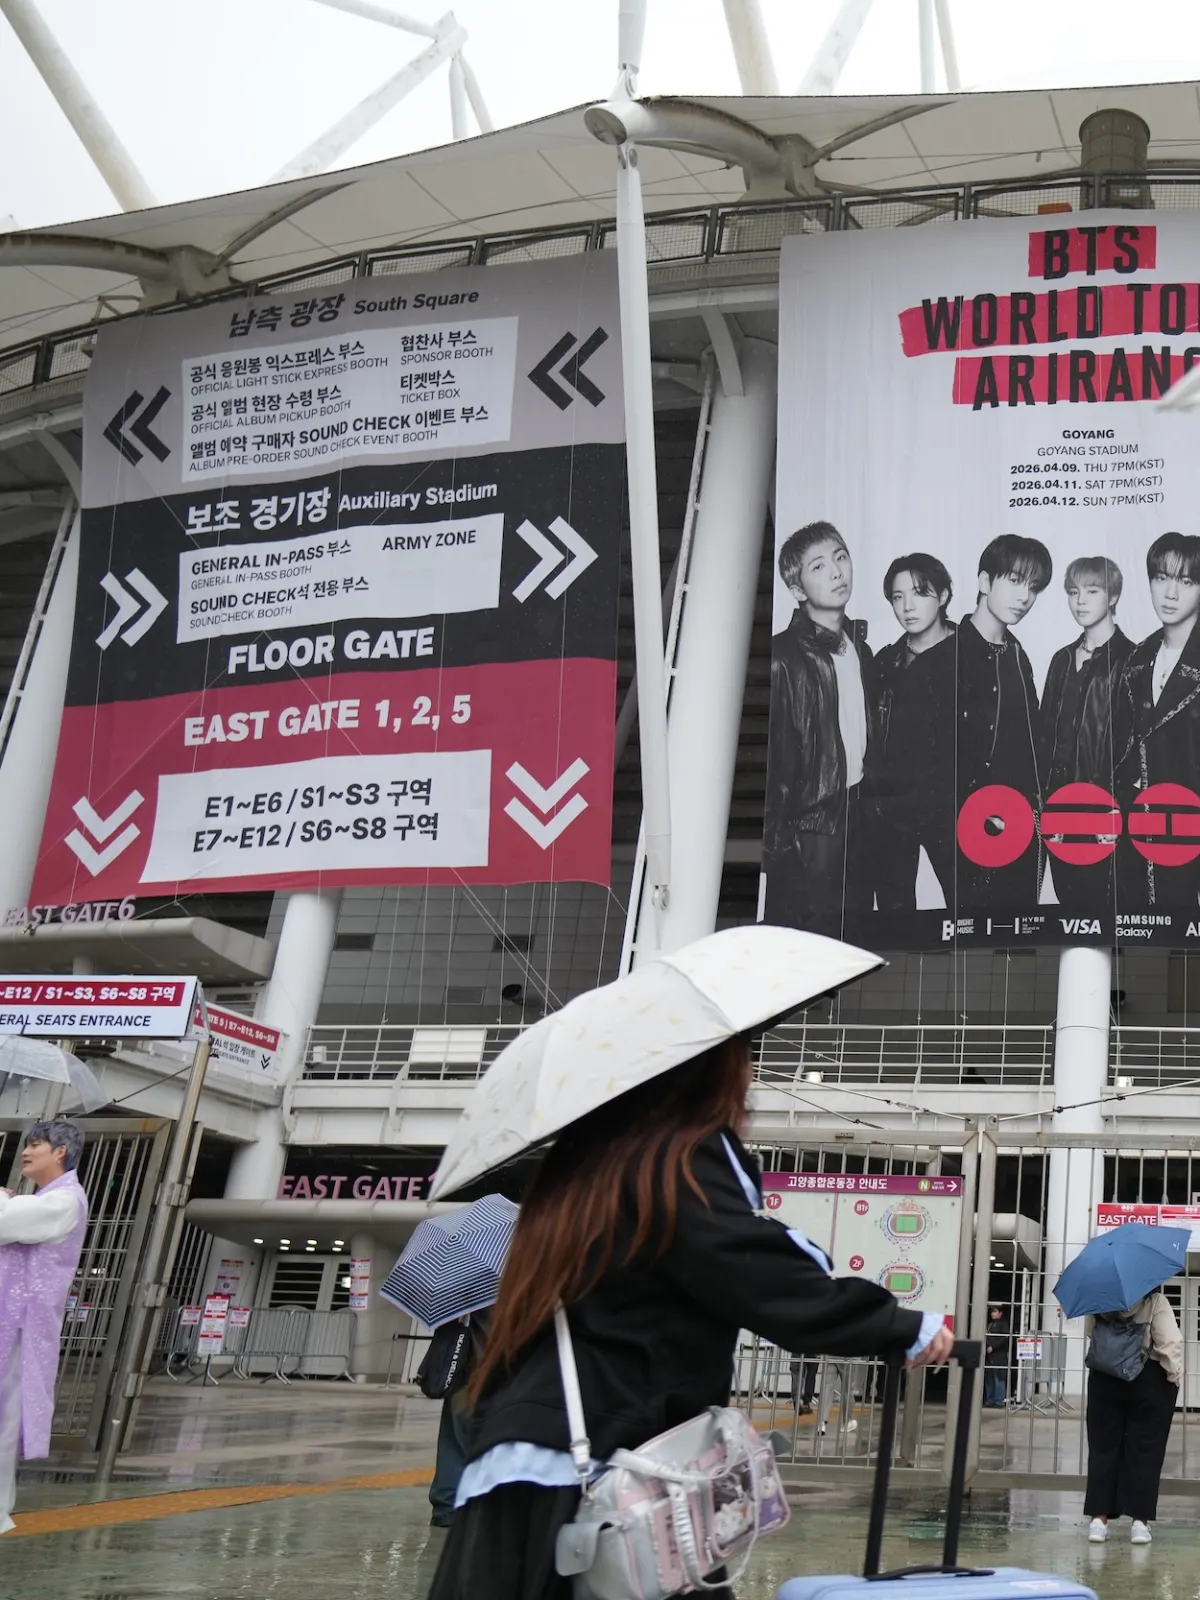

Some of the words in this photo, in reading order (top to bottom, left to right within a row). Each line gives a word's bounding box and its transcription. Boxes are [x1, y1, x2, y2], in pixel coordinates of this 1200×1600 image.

[1043, 225, 1139, 280] BTS
[229, 306, 282, 338] 남측
[289, 294, 346, 326] 광장
[353, 296, 407, 314] South
[413, 291, 479, 311] Square
[921, 285, 1104, 350] WORLD
[401, 333, 443, 352] 협찬사
[447, 330, 477, 347] 부스
[190, 363, 217, 383] 공식
[220, 357, 262, 378] 응원봉
[265, 347, 336, 372] 익스프레스
[339, 340, 365, 357] 부스
[400, 351, 451, 365] SPONSOR
[454, 347, 493, 359] BOOTH
[191, 380, 235, 396] OFFICIAL
[236, 376, 269, 388] LIGHT
[272, 373, 302, 385] STICK
[304, 363, 348, 380] EXPRESS
[350, 357, 388, 370] BOOTH
[400, 370, 456, 390] 티켓박스
[191, 402, 217, 422] 공식
[221, 396, 247, 416] 앨범
[252, 394, 281, 413] 현장
[285, 389, 313, 410] 수령
[317, 384, 342, 403] 부스
[400, 392, 435, 404] TICKET
[438, 388, 461, 399] BOX
[191, 420, 233, 435] OFFICIAL
[236, 414, 276, 427] ALBUM
[279, 409, 318, 422] PICKUP
[320, 400, 351, 416] BOOTH
[190, 439, 216, 459] 앨범
[220, 435, 248, 453] 예약
[251, 431, 295, 450] 구매자
[299, 421, 348, 444] SOUND
[352, 415, 411, 431] CHECK
[415, 408, 456, 428] 이벤트
[460, 405, 489, 424] 부스
[1062, 428, 1115, 440] GOYANG
[189, 458, 225, 472] ALBUM
[227, 449, 291, 466] PRE-ORDER
[293, 445, 328, 460] SOUND
[330, 438, 361, 452] CHECK
[363, 435, 400, 445] EVENT
[403, 430, 438, 443] BOOTH
[1037, 446, 1086, 456] GOYANG
[1089, 444, 1139, 456] STADIUM
[1010, 463, 1080, 474] 2026.04.09.
[1084, 463, 1108, 472] THU
[1111, 458, 1165, 472] 7PM(KST)
[1011, 479, 1082, 491] 2026.04.11.
[1085, 480, 1106, 489] SAT
[1109, 474, 1163, 489] 7PM(KST)
[184, 500, 241, 535] 보조
[250, 487, 332, 531] 경기장
[338, 491, 421, 513] Auxiliary
[426, 484, 498, 506] Stadium
[1009, 496, 1079, 508] 2026.04.12.
[1083, 497, 1107, 506] SUN
[1111, 492, 1165, 505] 7PM(KST)
[382, 534, 432, 551] ARMY
[435, 530, 477, 545] ZONE
[192, 555, 261, 575] GENERAL
[265, 545, 324, 567] IN-PASS
[326, 539, 351, 558] 부스
[191, 574, 232, 590] GENERAL
[235, 569, 277, 583] IN-PASS
[279, 565, 312, 579] BOOTH
[190, 595, 238, 614] SOUND
[313, 579, 339, 598] 전용
[342, 576, 369, 593] 부스
[190, 610, 255, 629] SOUNDCHECK
[257, 605, 292, 619] BOOTH
[228, 634, 335, 674] FLOOR
[343, 626, 435, 659] GATE
[184, 710, 270, 746] EAST
[278, 699, 360, 737] GATE
[375, 700, 402, 733] 1,
[411, 696, 440, 731] 2,
[451, 694, 471, 724] 5
[205, 792, 283, 818] E1~E6
[300, 783, 380, 808] S1~S3
[387, 778, 432, 806] 구역
[193, 824, 282, 853] E7~E12
[300, 818, 387, 842] S6~S8
[393, 813, 439, 841] 구역
[3, 905, 57, 926] EAST
[1116, 915, 1172, 925] SAMSUNG
[957, 926, 974, 934] MUSIC
[1058, 919, 1101, 934] VISA
[1115, 927, 1153, 939] Galaxy
[45, 987, 96, 1002] S1~S3,
[99, 987, 148, 1000] S6~S8
[150, 986, 176, 1001] 구역
[35, 1014, 77, 1026] SEATS
[79, 1015, 152, 1026] ENTRANCE
[277, 1175, 347, 1199] EAST
[352, 1175, 424, 1200] GATE
[788, 1176, 856, 1189] 고양종합운동장
[859, 1177, 888, 1190] 안내도
[920, 1181, 928, 1190] N
[769, 1197, 779, 1206] 1F
[857, 1204, 868, 1212] B1F
[1099, 1215, 1126, 1225] EAST
[1128, 1215, 1157, 1226] GATE
